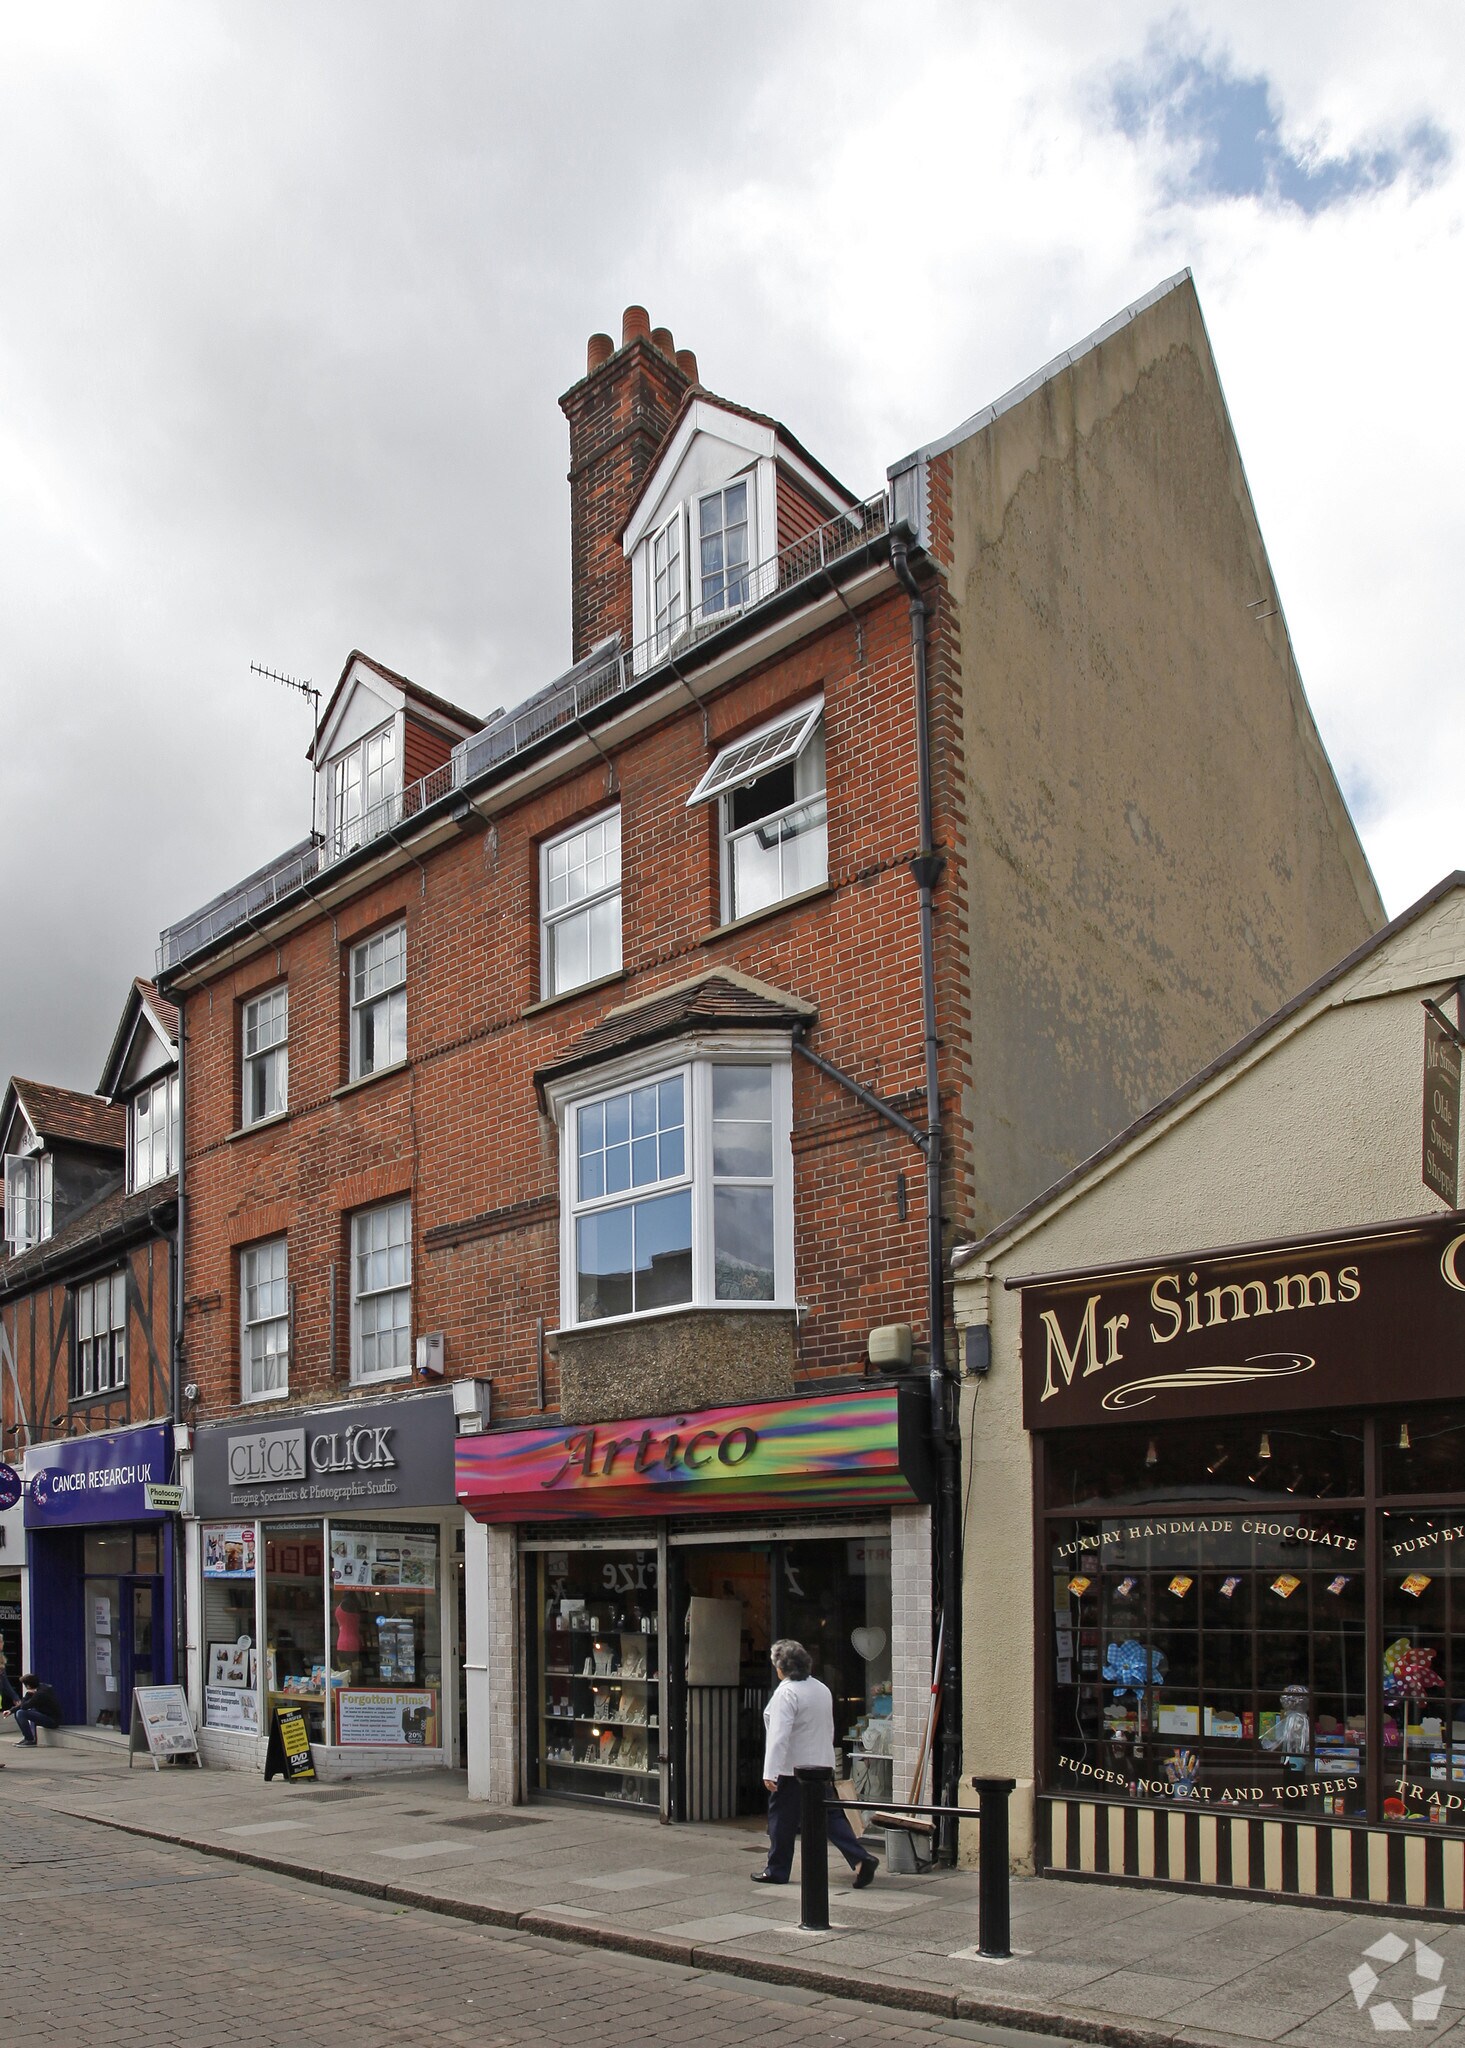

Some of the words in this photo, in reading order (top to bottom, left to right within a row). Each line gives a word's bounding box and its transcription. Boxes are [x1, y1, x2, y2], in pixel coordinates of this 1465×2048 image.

[1426, 1037, 1439, 1068] Mr
[1433, 1089, 1452, 1127] Olde
[1430, 1118, 1453, 1161] Sweet
[1426, 1149, 1454, 1195] Shoppe
[1039, 1294, 1130, 1402] Mr
[1150, 1266, 1361, 1343] Simms
[540, 1417, 758, 1488] Artico
[52, 1473, 86, 1493] CANCER
[88, 1466, 135, 1489] RESEARCH
[137, 1463, 152, 1482] UK
[150, 1487, 182, 1499] Photocopy
[230, 1491, 259, 1506] Imaging
[260, 1487, 298, 1505] Specialists
[300, 1486, 309, 1499] &
[310, 1483, 366, 1501] Photographic
[367, 1478, 398, 1494] Studio
[1058, 1530, 1122, 1558] LUXURY
[1129, 1520, 1233, 1539] HANDMADE
[1241, 1521, 1358, 1551] CHOCOLATE
[1392, 1525, 1465, 1557] PURVEY
[341, 1693, 393, 1706] Forgotten
[396, 1695, 429, 1705] Films?
[291, 1752, 308, 1764] DVD
[1058, 1755, 1129, 1788] FUDGES,
[1138, 1778, 1212, 1799] NOUGAT
[1222, 1787, 1264, 1800] AND
[1272, 1777, 1358, 1799] TOFFEES
[1394, 1778, 1465, 1812] TRAD
